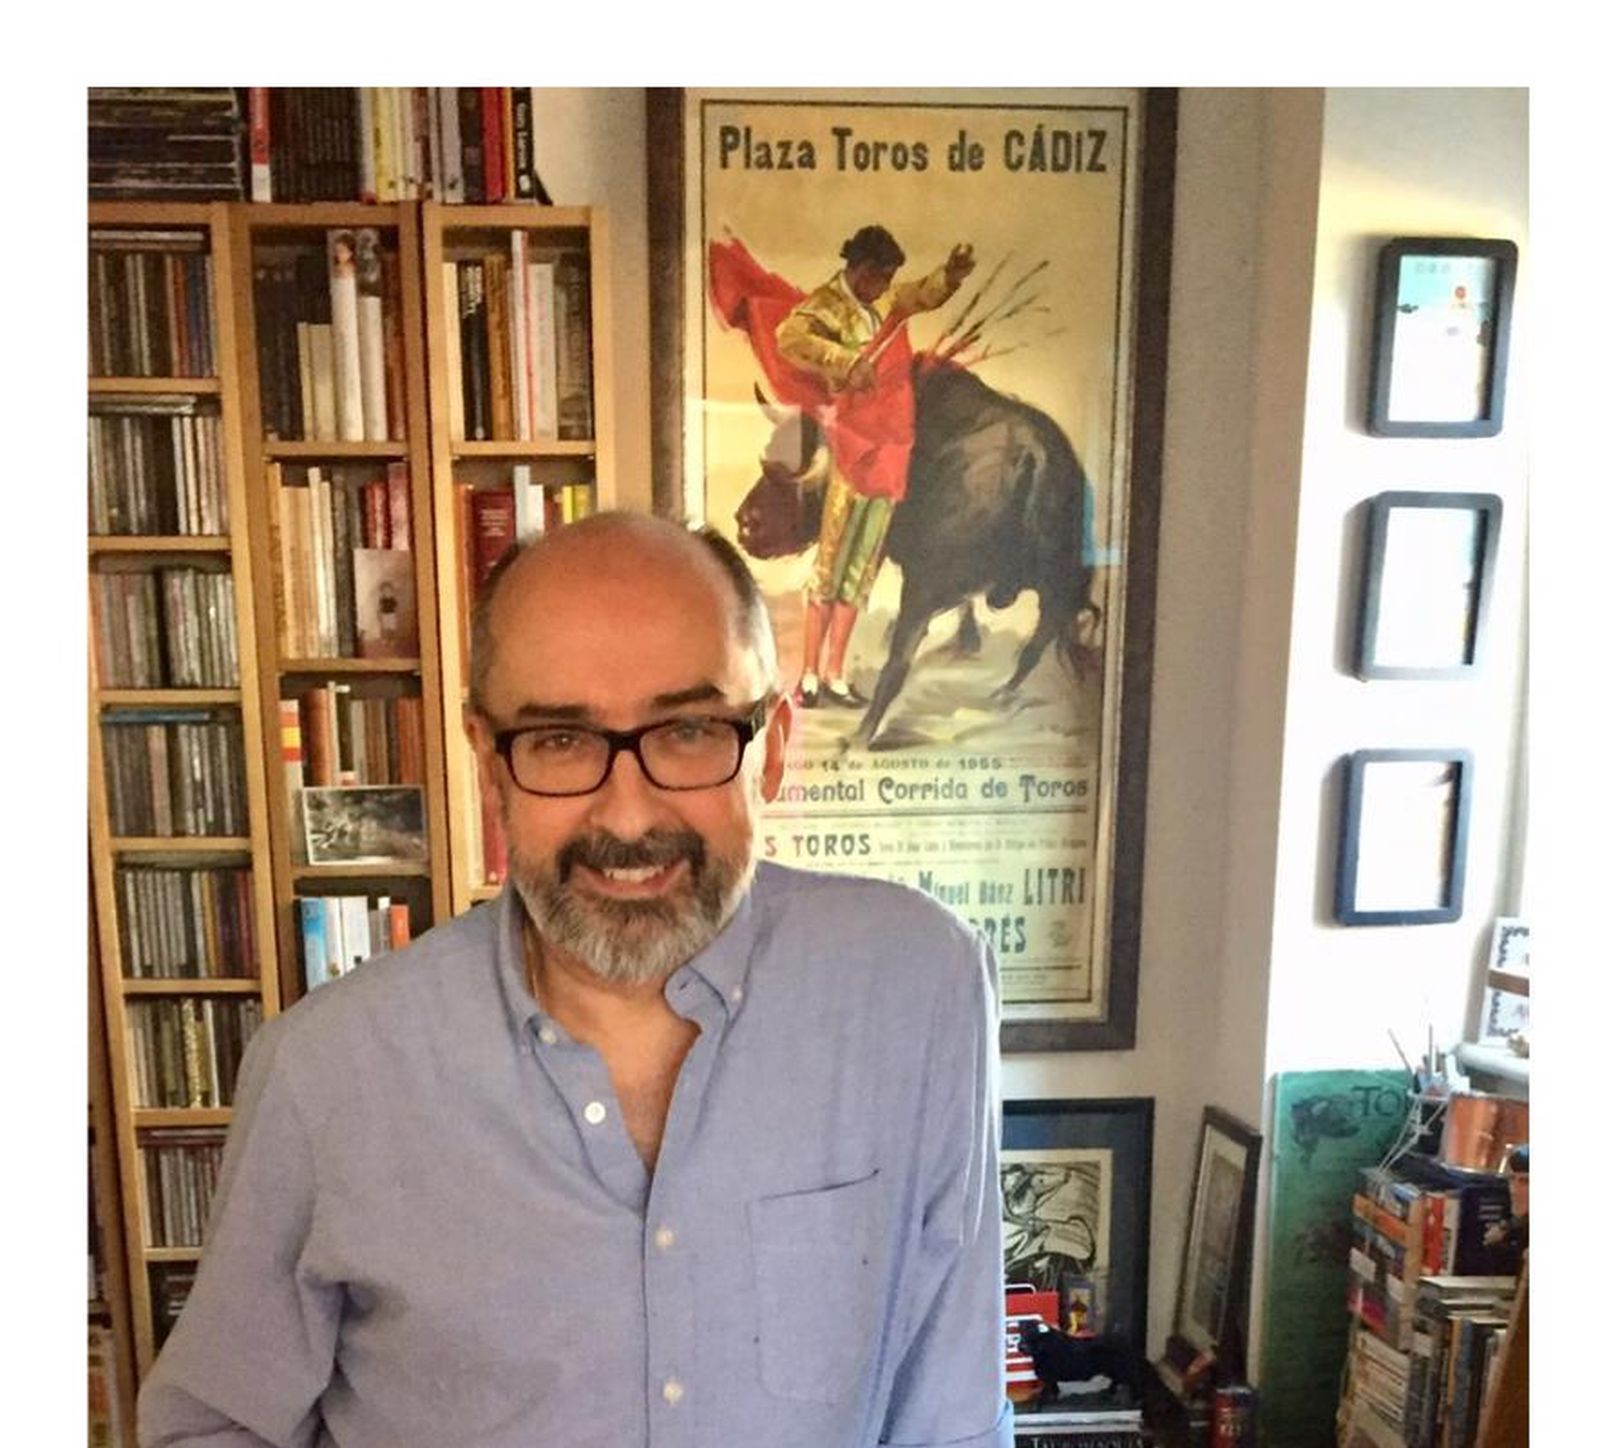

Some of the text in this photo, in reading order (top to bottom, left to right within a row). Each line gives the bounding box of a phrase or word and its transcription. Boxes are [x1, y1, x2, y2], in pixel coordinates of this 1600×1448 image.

[719, 123, 1109, 173] Plaza Toros de CÁDIZ
[872, 758, 930, 770] AGOSTO
[877, 776, 968, 805] Corrida
[981, 777, 1008, 799] de
[1019, 774, 1088, 802] Toros
[792, 833, 872, 857] TOROS
[1023, 867, 1087, 907] LITRI
